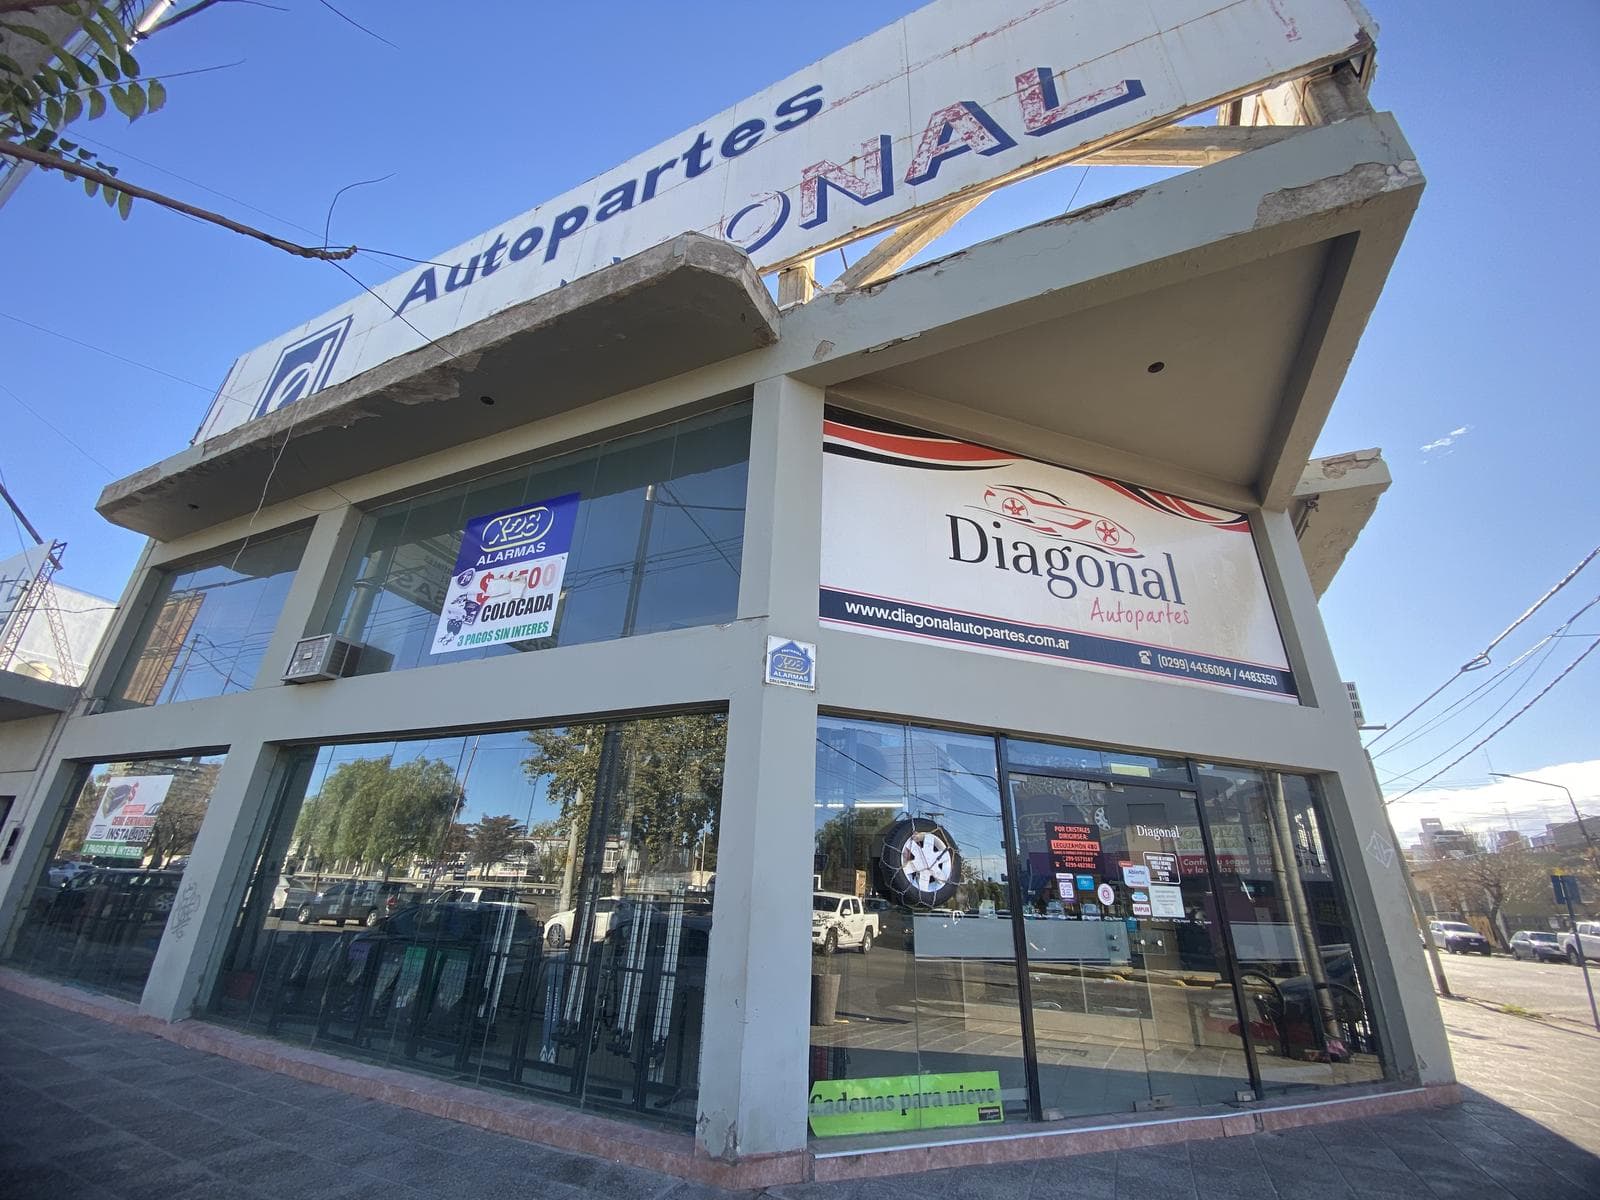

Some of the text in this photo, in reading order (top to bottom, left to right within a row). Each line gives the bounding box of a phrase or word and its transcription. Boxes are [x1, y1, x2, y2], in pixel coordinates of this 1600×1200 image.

[722, 66, 1147, 254] ONAL
[392, 84, 824, 318] Autopartes
[476, 541, 547, 566] ALARMAS
[945, 514, 1186, 606] Diagonal
[481, 593, 554, 622] COLOCADA
[1090, 597, 1190, 630] Autopartes
[457, 621, 549, 647] 3 PAGOS SIN INTERES
[845, 601, 1070, 650] www.diagonalautopartes.com.ar
[773, 670, 809, 682] ALARMAS
[1157, 654, 1190, 672] (0299)
[1190, 661, 1232, 678] 4436084
[1238, 669, 1278, 686] 4483350
[1136, 824, 1180, 841] Diagonal
[810, 1085, 996, 1116] Cadenas para nieve
